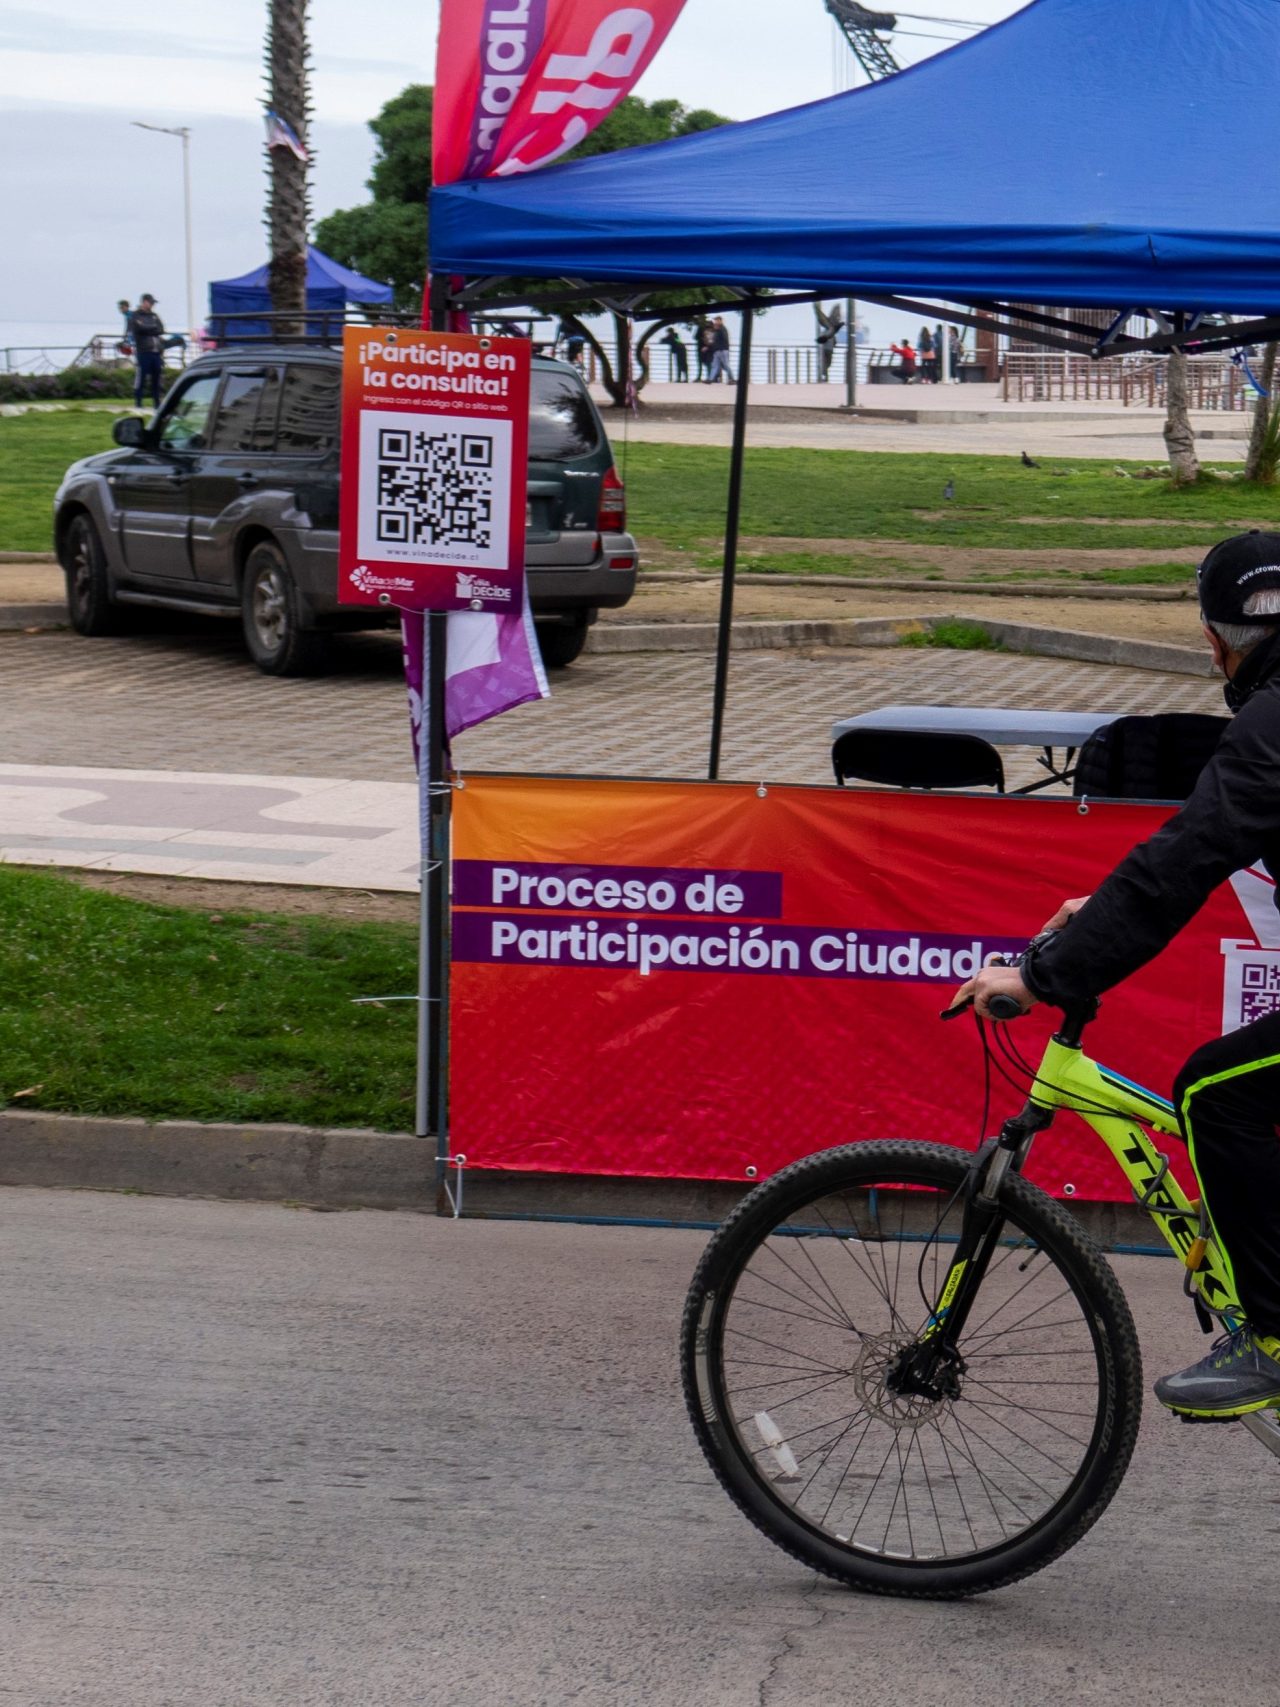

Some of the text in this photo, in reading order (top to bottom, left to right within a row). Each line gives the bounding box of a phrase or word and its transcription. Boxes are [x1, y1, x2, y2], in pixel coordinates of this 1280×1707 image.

[359, 342, 516, 373] ¡Participa en
[363, 366, 509, 396] la consulta!
[491, 867, 744, 914] Proceso de
[491, 921, 800, 976] Participación
